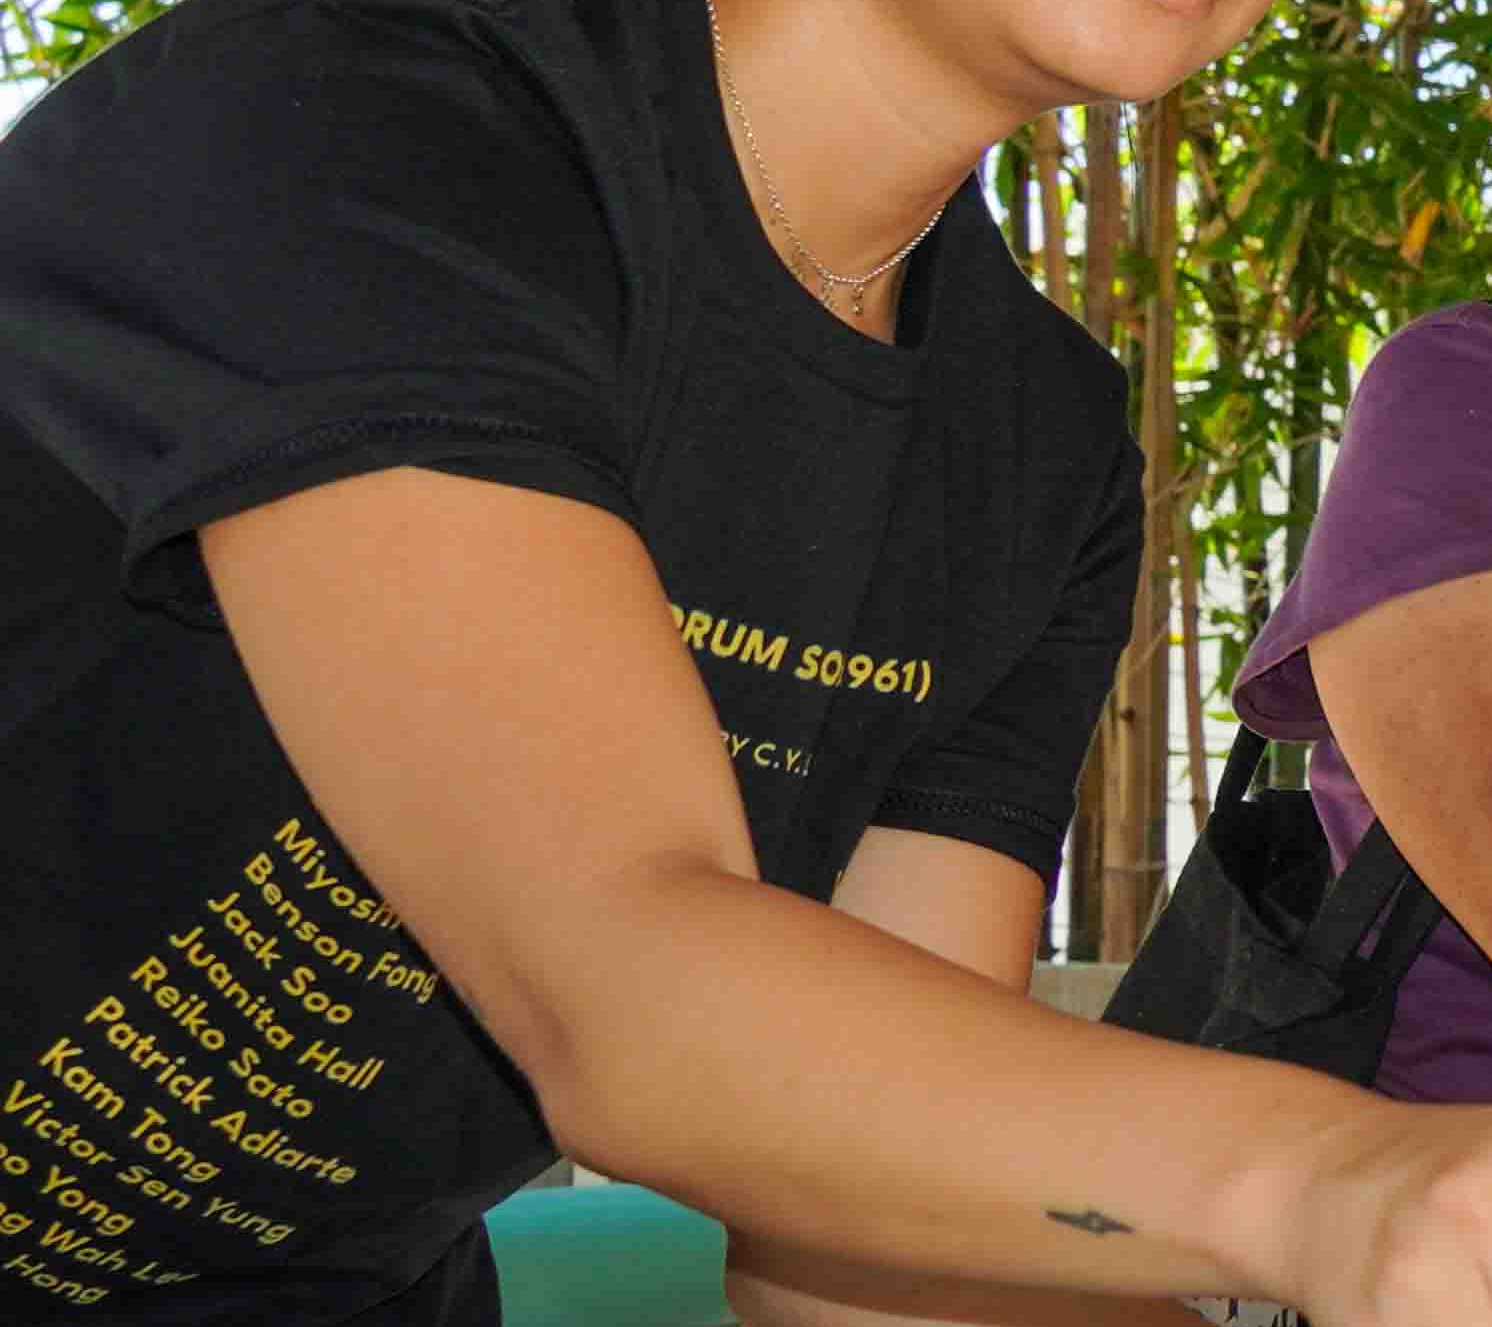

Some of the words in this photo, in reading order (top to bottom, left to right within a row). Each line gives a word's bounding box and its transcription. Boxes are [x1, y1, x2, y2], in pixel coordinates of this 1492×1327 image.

[208, 892, 281, 970] Jack
[281, 966, 353, 1024] Soo
[244, 853, 363, 973] Benson
[367, 952, 437, 1004] Fong
[130, 956, 225, 1051] Reiko
[230, 1047, 313, 1118] Sato
[169, 926, 295, 1050] Juanita
[297, 1040, 384, 1090] Hall
[3, 1080, 116, 1165] Victor
[116, 1165, 191, 1210] Sen
[202, 1196, 295, 1245] Yung
[39, 1038, 126, 1118] Kam
[130, 1107, 222, 1183] Tong
[84, 995, 216, 1114] Patrick
[210, 1109, 356, 1184] Adiarte
[40, 1221, 127, 1271] Wah
[41, 1165, 135, 1236] Yong
[2, 1254, 109, 1304] Hong
